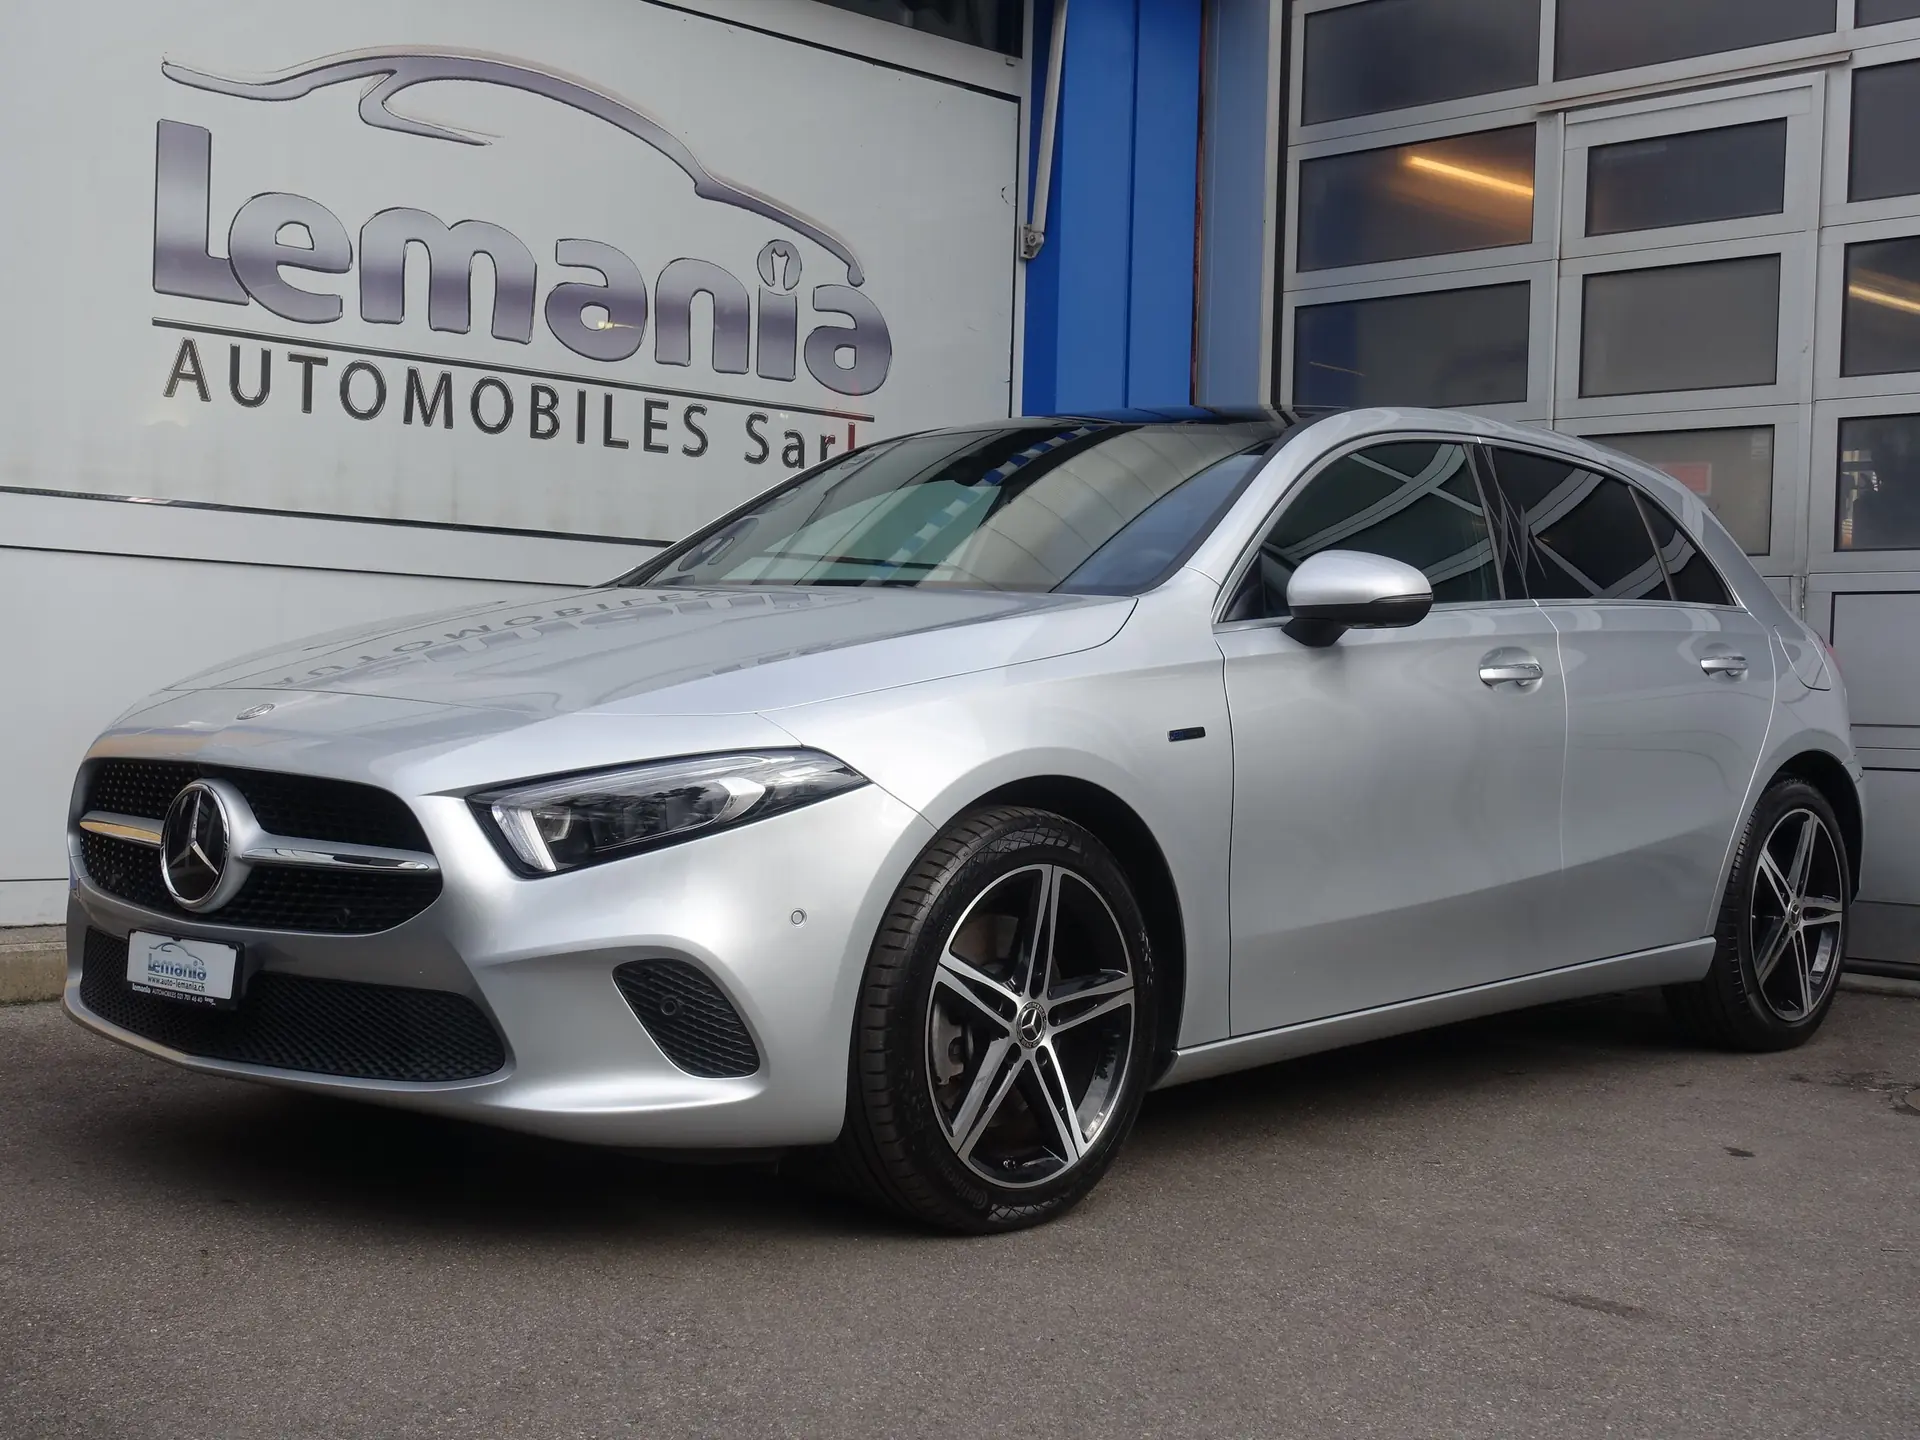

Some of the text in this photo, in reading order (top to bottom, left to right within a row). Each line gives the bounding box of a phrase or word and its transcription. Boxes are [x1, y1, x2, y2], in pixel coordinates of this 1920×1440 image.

[152, 118, 893, 397] Lemania
[163, 336, 710, 459] AUTOMOBILES
[147, 952, 208, 982] Lemania
[147, 975, 206, 993] www.auto-lemania.ch
